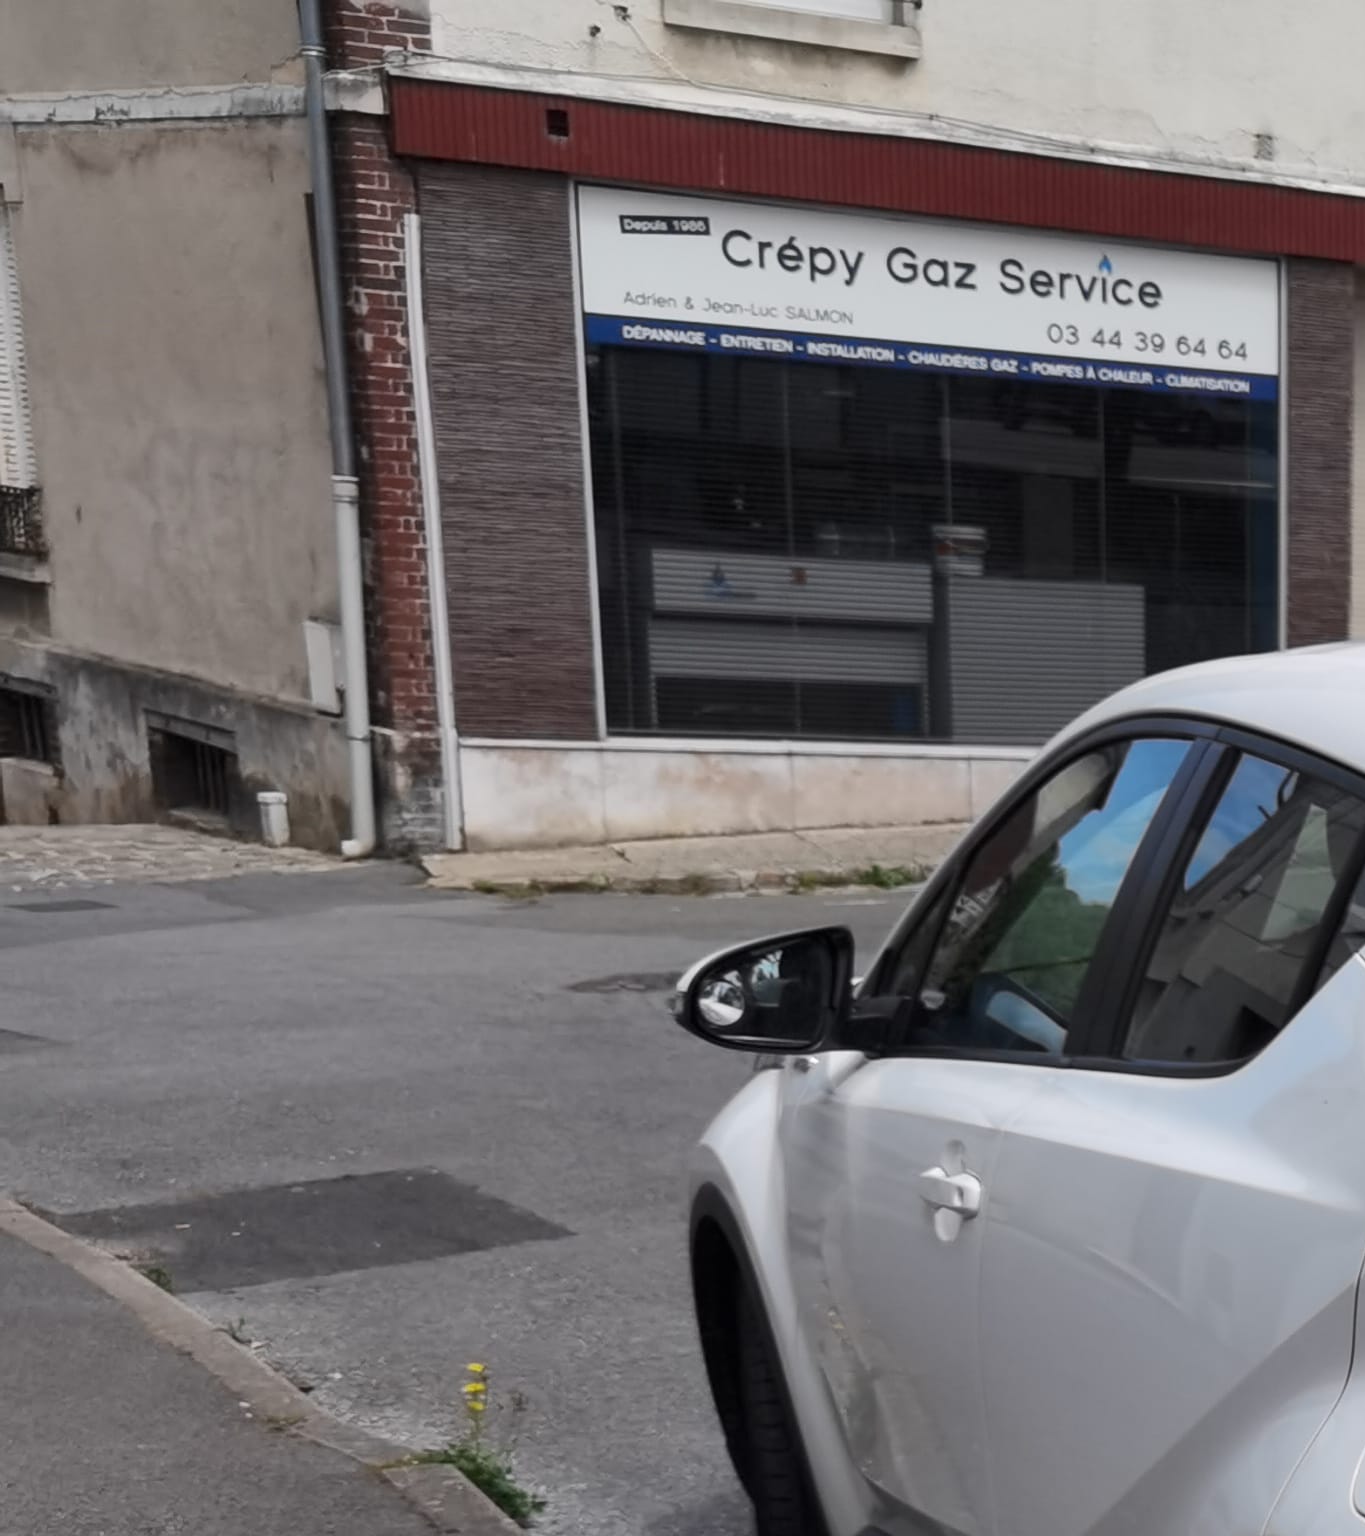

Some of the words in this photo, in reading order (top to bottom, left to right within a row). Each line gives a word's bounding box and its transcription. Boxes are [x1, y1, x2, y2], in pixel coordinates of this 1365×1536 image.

[623, 218, 668, 232] Depuis
[721, 229, 864, 286] Crépy
[886, 246, 977, 290] Gaz
[999, 256, 1163, 308] Service
[623, 291, 677, 309] Adrien
[684, 296, 694, 310] &
[703, 298, 778, 319] Jean-Luc
[785, 303, 854, 325] SALMON
[621, 324, 706, 346] DÉPANNAGE
[720, 333, 794, 353] ENTRETIEN
[806, 342, 894, 363] INSTALLATION
[990, 358, 1019, 374] GAZ
[1031, 361, 1084, 380] POMPES
[1097, 368, 1153, 386] CHALEUR
[1165, 374, 1250, 394] CLIMATISATION
[1046, 323, 1080, 345] 03
[1091, 328, 1122, 349] 44
[1134, 331, 1166, 354] 39
[1175, 335, 1207, 358] 64
[1217, 339, 1248, 362] 64
